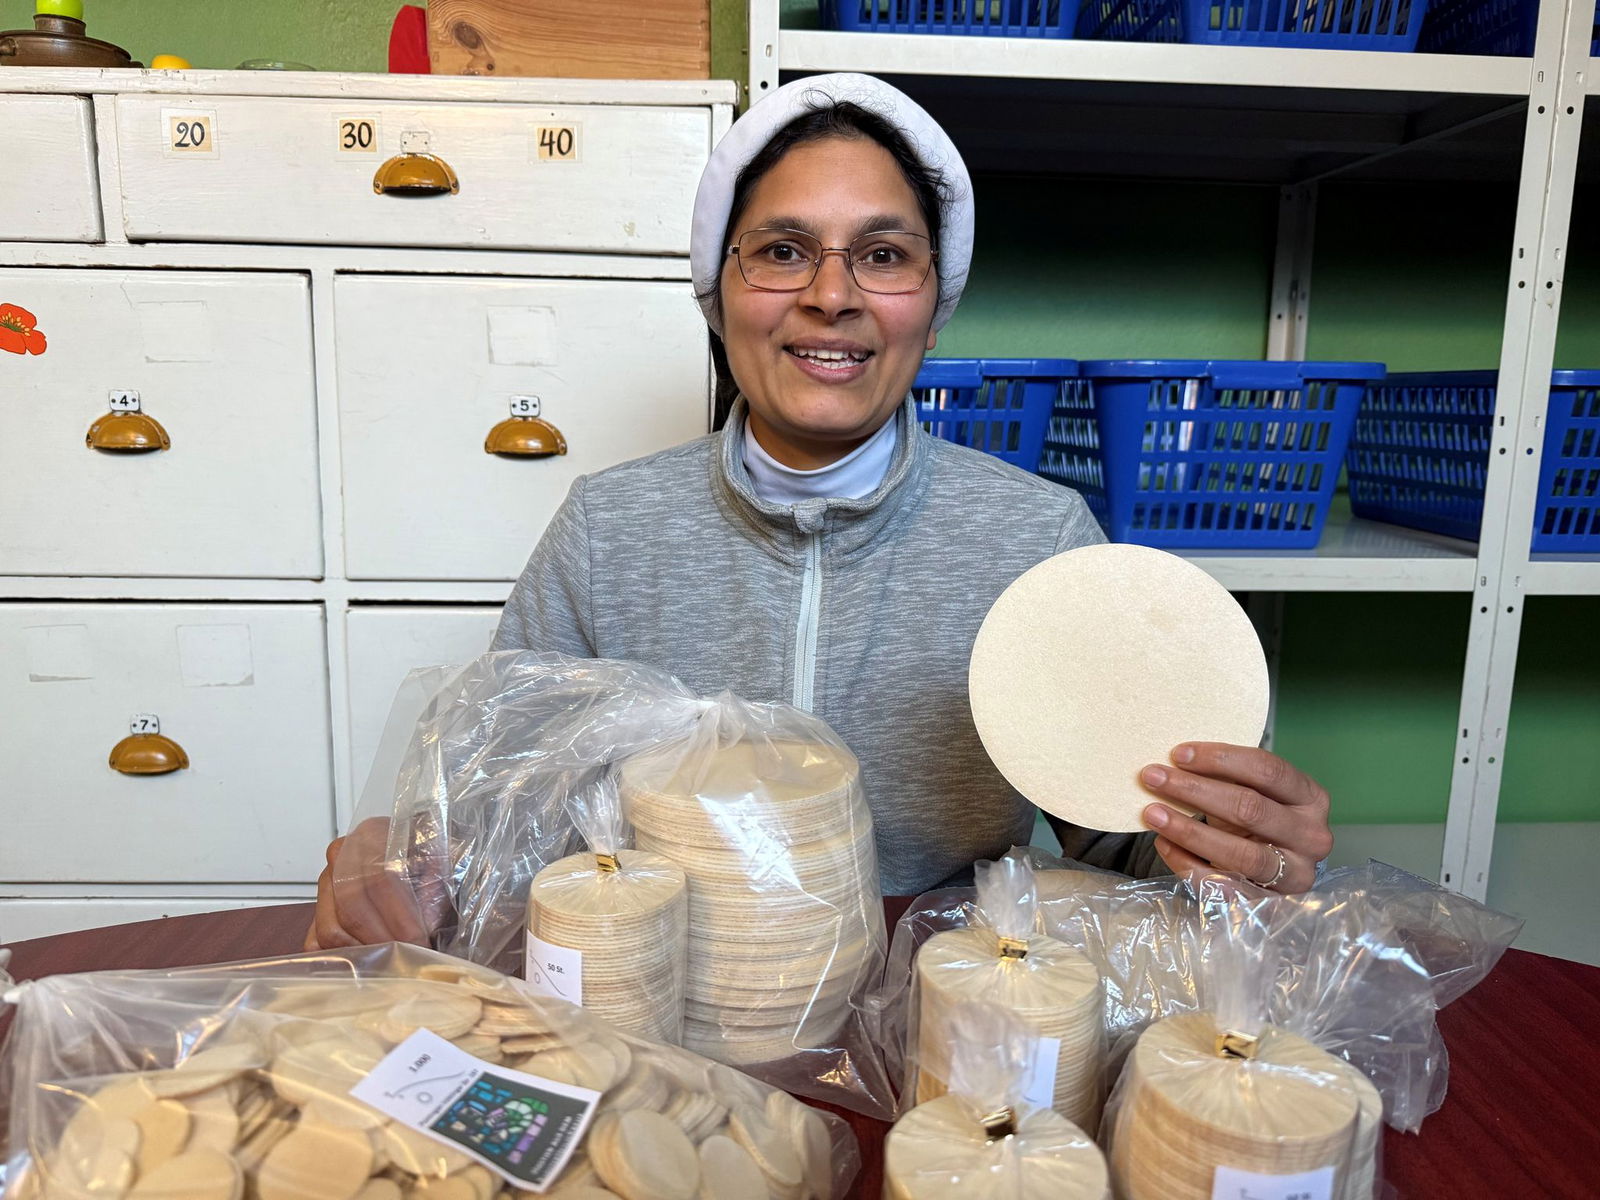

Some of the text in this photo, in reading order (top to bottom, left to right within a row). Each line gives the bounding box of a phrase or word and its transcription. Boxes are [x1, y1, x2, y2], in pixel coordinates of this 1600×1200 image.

[174, 121, 206, 148] 20
[342, 121, 374, 149] 30
[539, 127, 574, 157] 40
[119, 394, 129, 407] 4
[520, 399, 530, 411] 5
[140, 719, 149, 731] 7
[547, 962, 556, 971] 50
